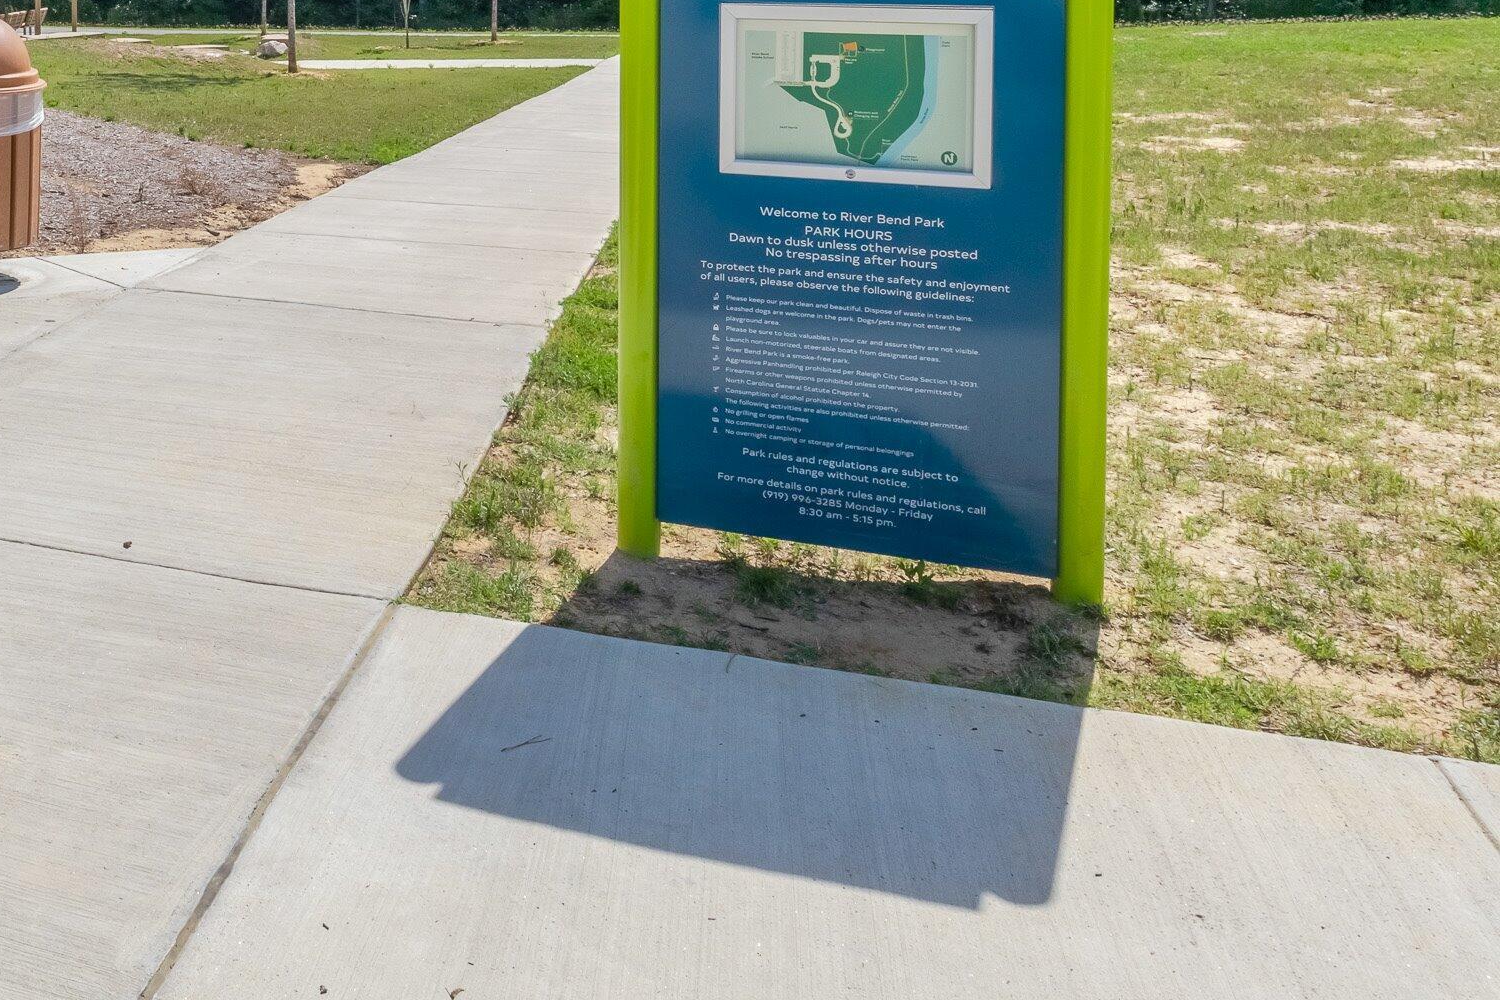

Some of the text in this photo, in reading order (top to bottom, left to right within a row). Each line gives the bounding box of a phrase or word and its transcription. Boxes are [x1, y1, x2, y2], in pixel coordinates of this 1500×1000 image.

[760, 207, 944, 228] Welcome to River Bend Park
[804, 226, 893, 240] PARK HOURS
[730, 232, 977, 260] Dawn to dusk unless otherwise posted
[766, 247, 937, 269] No trespassing after hours
[700, 272, 974, 302] of all users, please observe the following guidelines:
[701, 260, 1009, 293] To protect the park and ensure the safety and enjoyment
[749, 296, 765, 305] keep
[864, 307, 893, 315] Dispose
[726, 316, 762, 324] playground
[804, 344, 836, 352] steerable
[878, 351, 918, 360] designated
[725, 387, 770, 397] Consumption
[806, 397, 842, 406] prohibited
[736, 409, 758, 418] grilling
[786, 415, 809, 423] flames
[736, 420, 774, 429] commercial
[776, 425, 801, 434] activity
[735, 431, 767, 439] overnight
[769, 435, 798, 444] camping
[808, 439, 834, 448] storage
[845, 444, 875, 452] personal
[876, 447, 914, 458] belongings
[743, 447, 958, 482] Park rules and regulations are subject to
[786, 465, 910, 488] change without notice.
[717, 472, 986, 515] For more details on park rules and regulations, call
[762, 489, 789, 502] (919)
[791, 493, 842, 508] 996-3285
[845, 501, 888, 516] Monday
[899, 508, 933, 522] Friday
[799, 506, 823, 517] 8:30
[826, 512, 842, 520] am
[853, 514, 873, 524] 5:15
[876, 519, 896, 528] pm.
